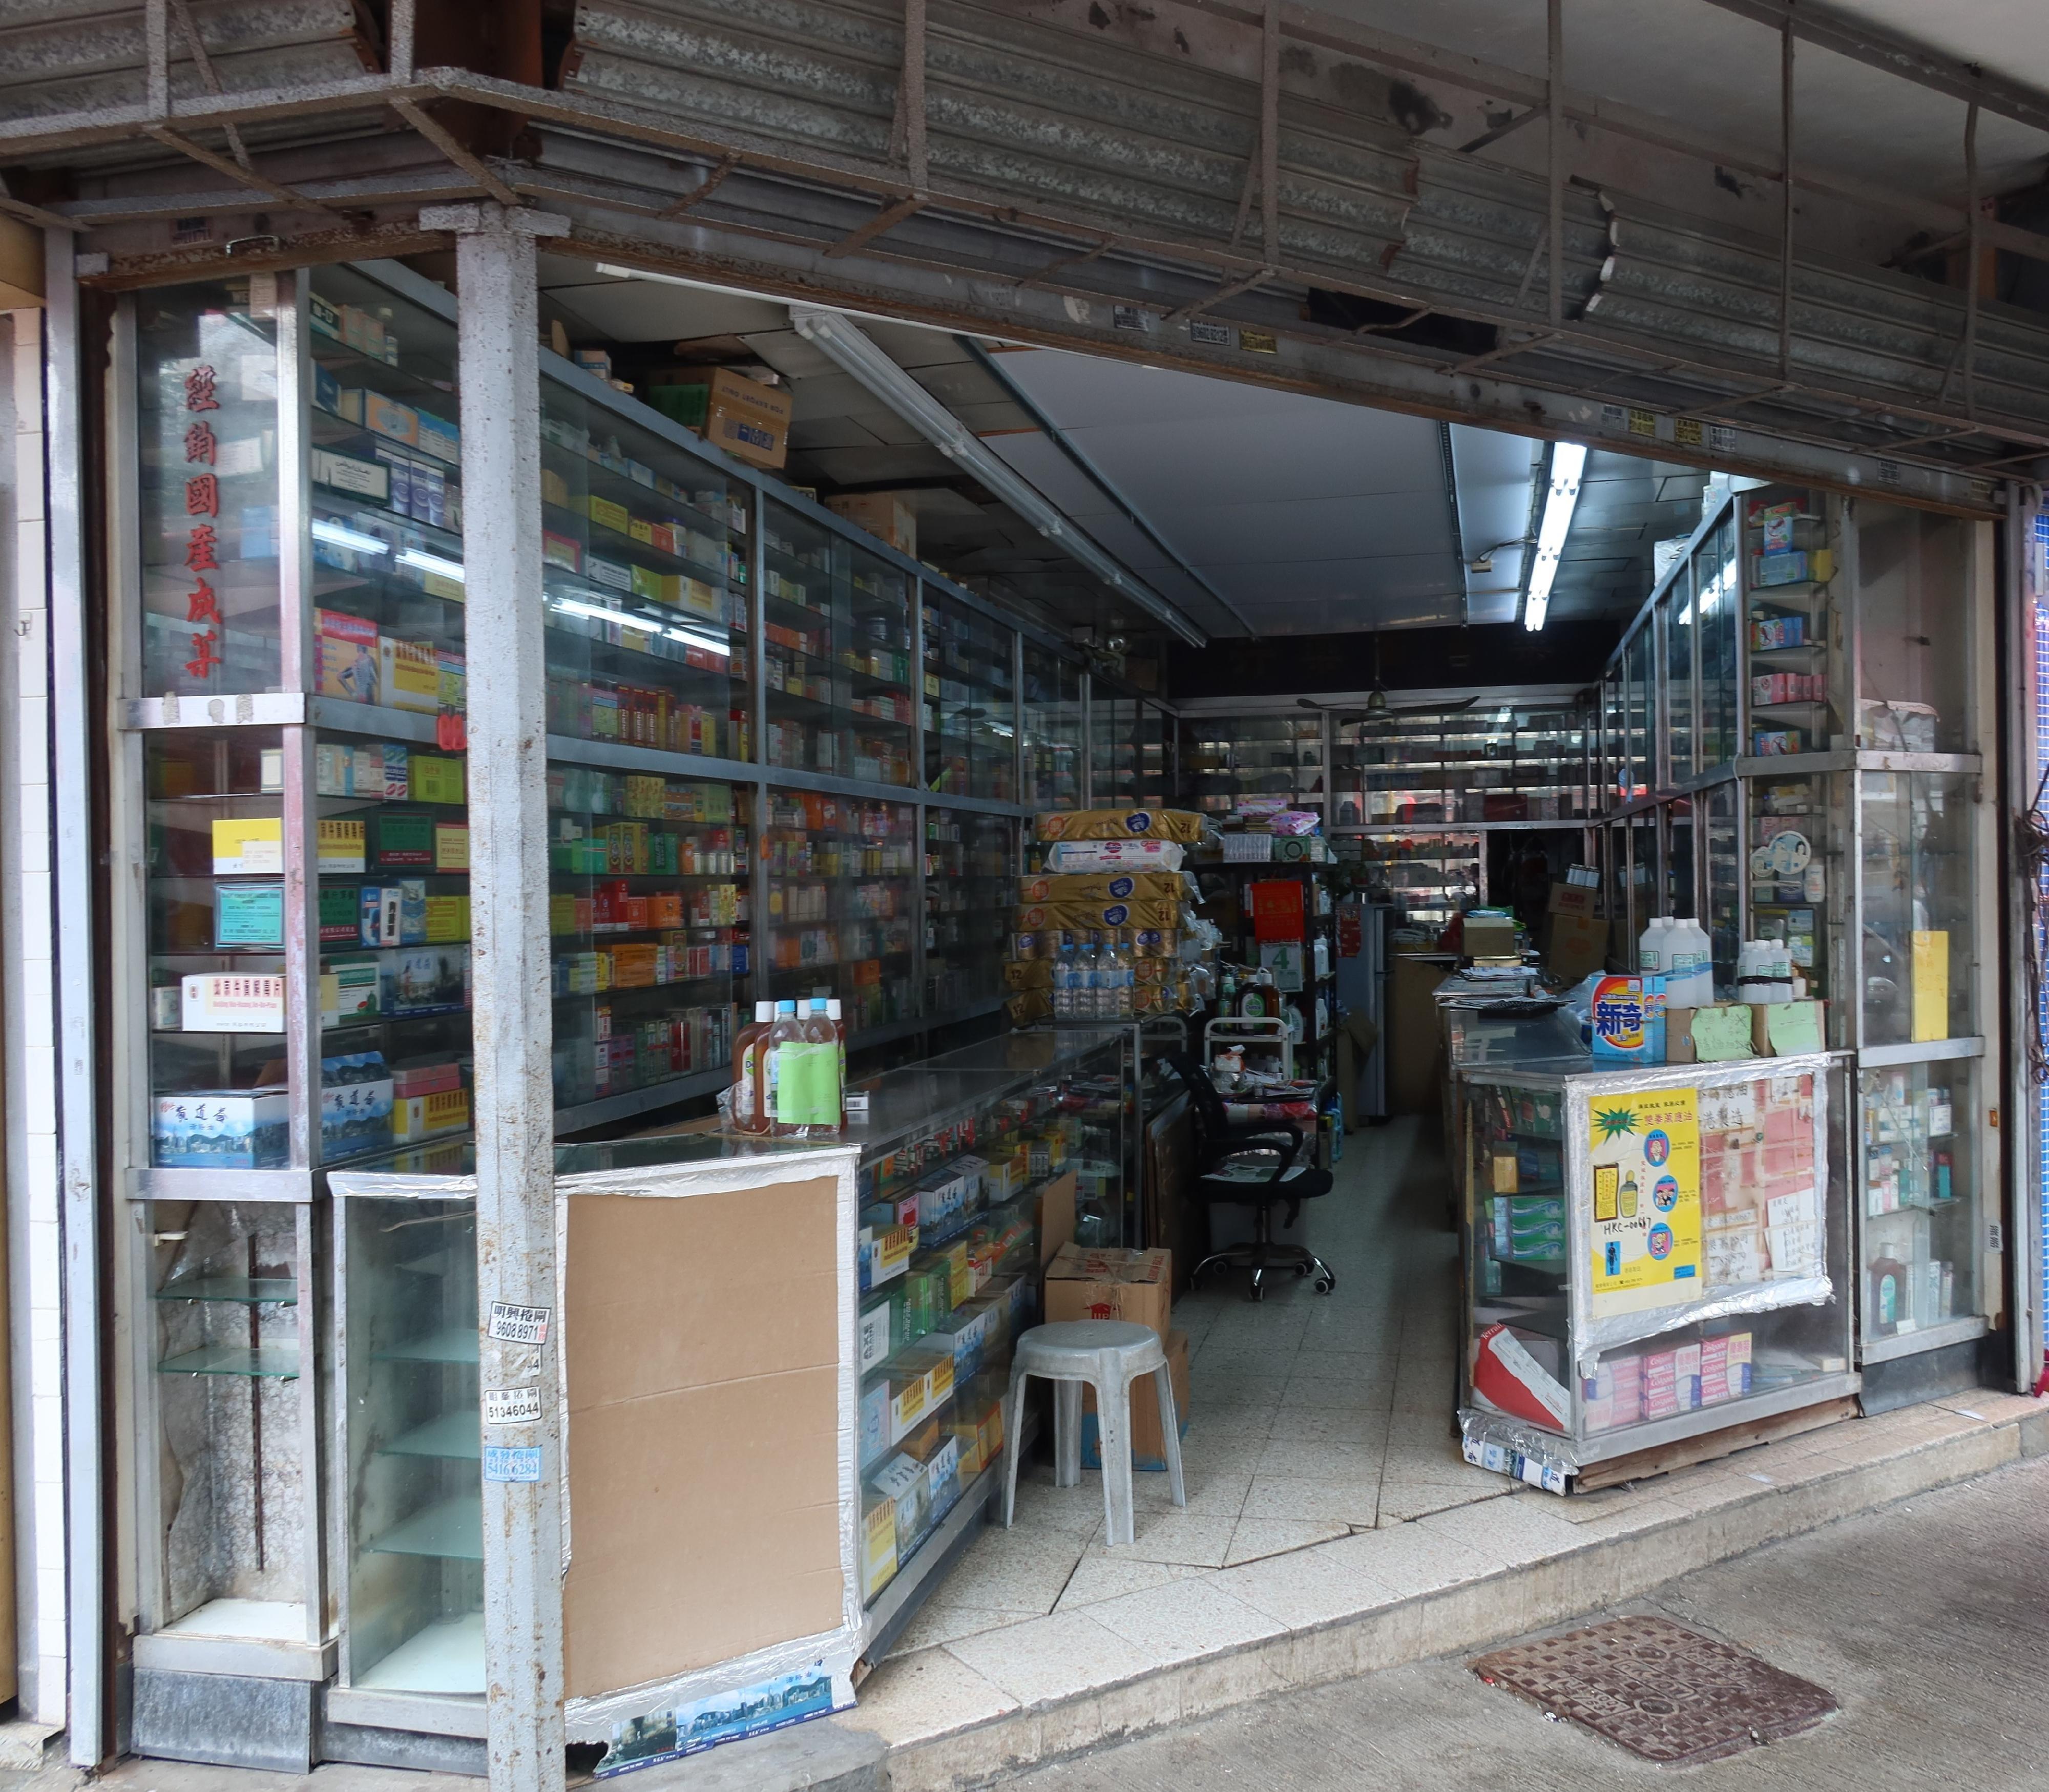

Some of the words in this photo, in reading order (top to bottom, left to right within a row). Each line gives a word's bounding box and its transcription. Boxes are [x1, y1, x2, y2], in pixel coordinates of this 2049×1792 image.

[1180, 823, 1191, 833] 12
[1164, 882, 1175, 893] 12
[1158, 911, 1170, 921] 12
[1272, 947, 1290, 969] 4
[1011, 969, 1023, 980] 12
[1013, 1003, 1025, 1015] 12
[1596, 1001, 1642, 1037] 新奇
[1703, 1341, 1727, 1353] Colgate
[1703, 1363, 1726, 1374] Colgate
[1650, 1375, 1674, 1387] Colgate
[1703, 1383, 1727, 1394] Colgate
[1651, 1396, 1675, 1407] Colgate
[488, 1402, 539, 1418] 51346044
[487, 1461, 537, 1475] 54166284
